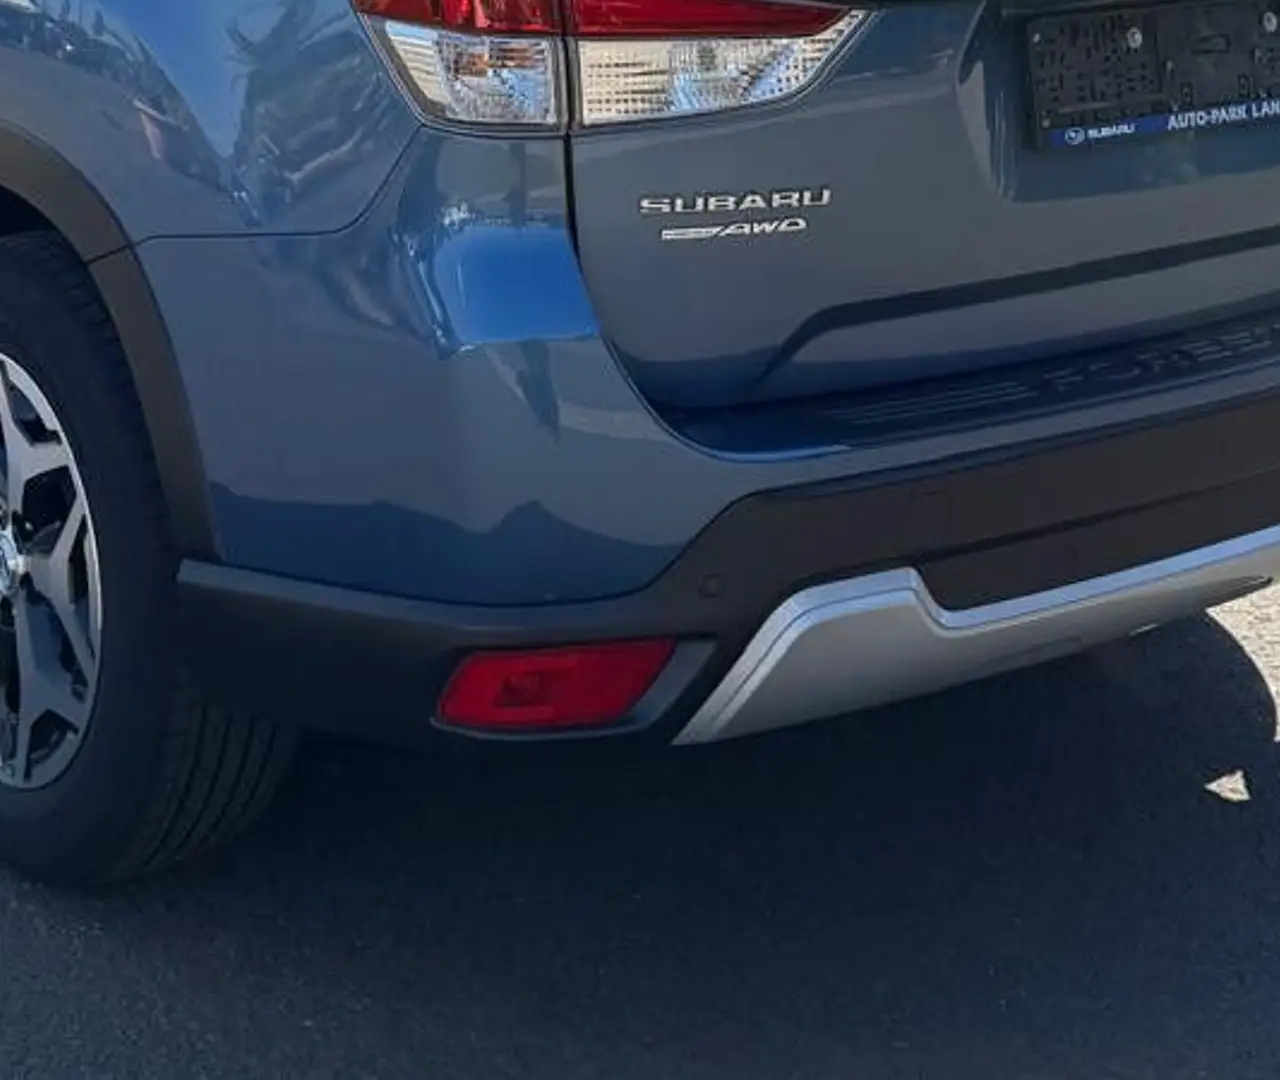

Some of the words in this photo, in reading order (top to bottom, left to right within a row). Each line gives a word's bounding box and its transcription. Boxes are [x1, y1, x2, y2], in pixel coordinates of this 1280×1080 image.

[1167, 104, 1248, 131] AUTO-PARK
[639, 187, 832, 214] SUBARU
[720, 217, 808, 237] AWD
